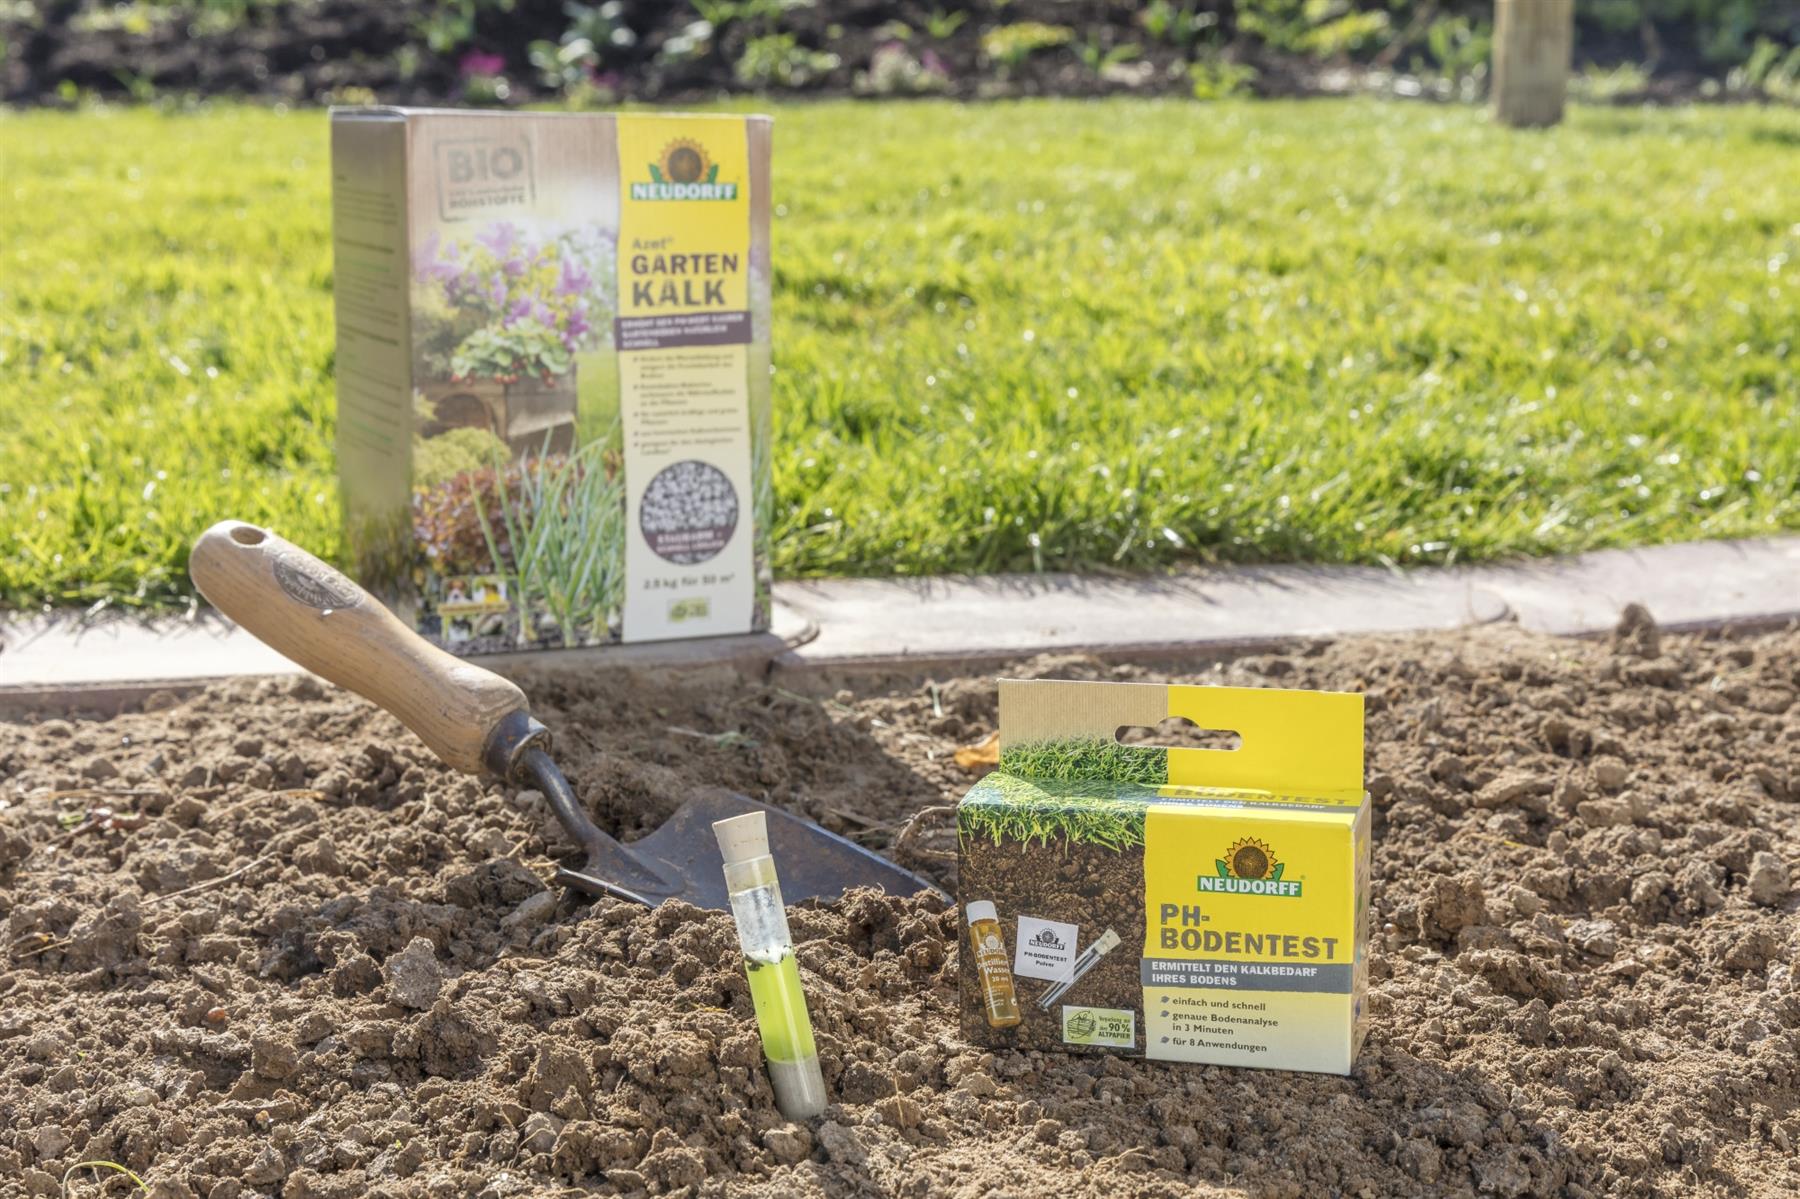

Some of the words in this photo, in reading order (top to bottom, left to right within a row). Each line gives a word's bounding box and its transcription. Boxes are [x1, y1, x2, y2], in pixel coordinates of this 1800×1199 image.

[447, 147, 524, 183] BIO
[632, 183, 734, 200] NEUDORFF
[631, 253, 738, 275] GARTEN
[633, 280, 726, 307] KALK
[1200, 877, 1300, 896] NEUDORFF
[1160, 903, 1211, 927] PH-
[1160, 927, 1339, 960] BODENTEST
[1152, 961, 1211, 973] ERMITTELT
[1214, 964, 1238, 974] DEN
[1241, 965, 1318, 977] KALKBEDARF
[1152, 974, 1186, 984] IHRES
[1190, 975, 1237, 986] BODENS
[1172, 997, 1208, 1007] einfach
[1211, 1000, 1229, 1008] und
[1232, 1001, 1266, 1011] schnell
[1172, 1012, 1208, 1021] genaue
[1211, 1013, 1278, 1028] Bodenanalyse
[1098, 1031, 1131, 1039] ALTPAPIER
[1172, 1023, 1182, 1032] in
[1185, 1023, 1190, 1032] 3
[1193, 1024, 1234, 1035] Minuten
[1172, 1037, 1187, 1046] für
[1189, 1038, 1195, 1047] 8
[1197, 1038, 1267, 1053] Anwendungen
